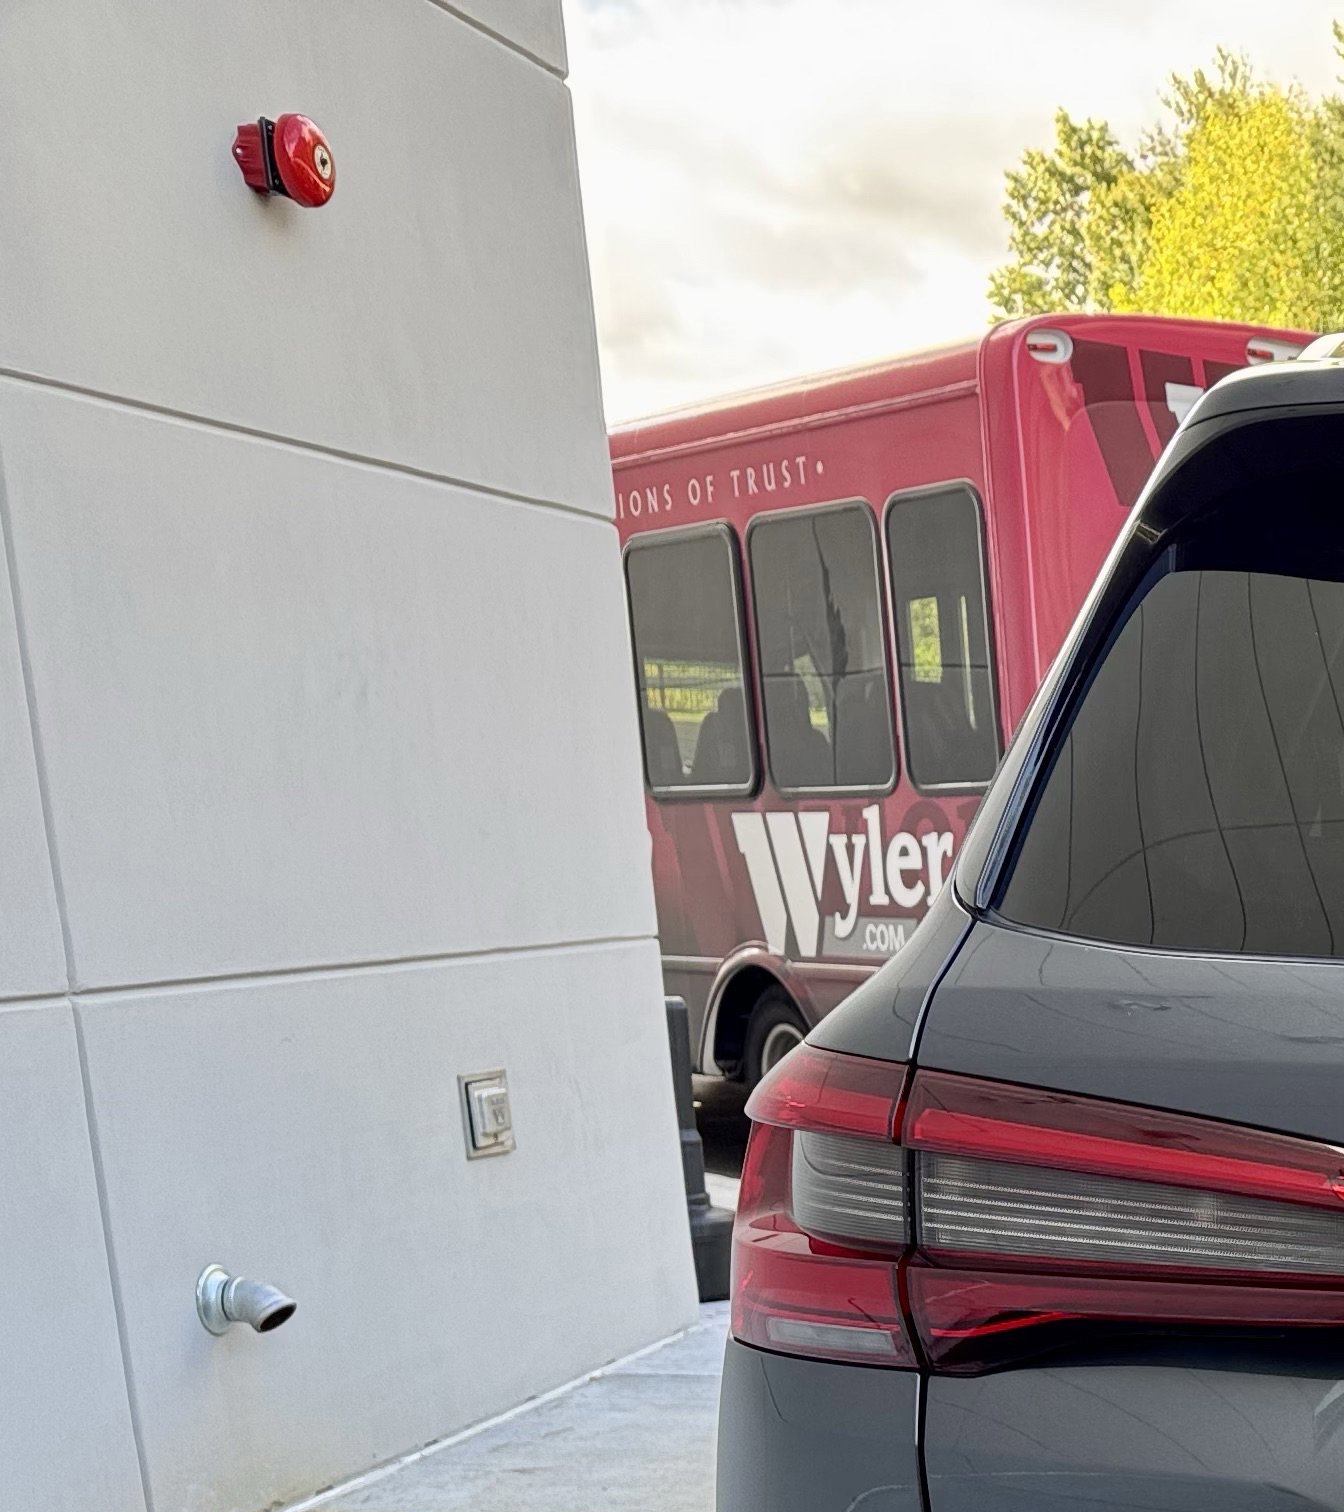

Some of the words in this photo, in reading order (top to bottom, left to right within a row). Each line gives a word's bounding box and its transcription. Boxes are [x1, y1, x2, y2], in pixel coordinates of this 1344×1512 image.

[618, 483, 673, 520] IONS
[687, 474, 715, 506] OF
[729, 455, 807, 498] TRUST
[730, 803, 954, 958] Wyler
